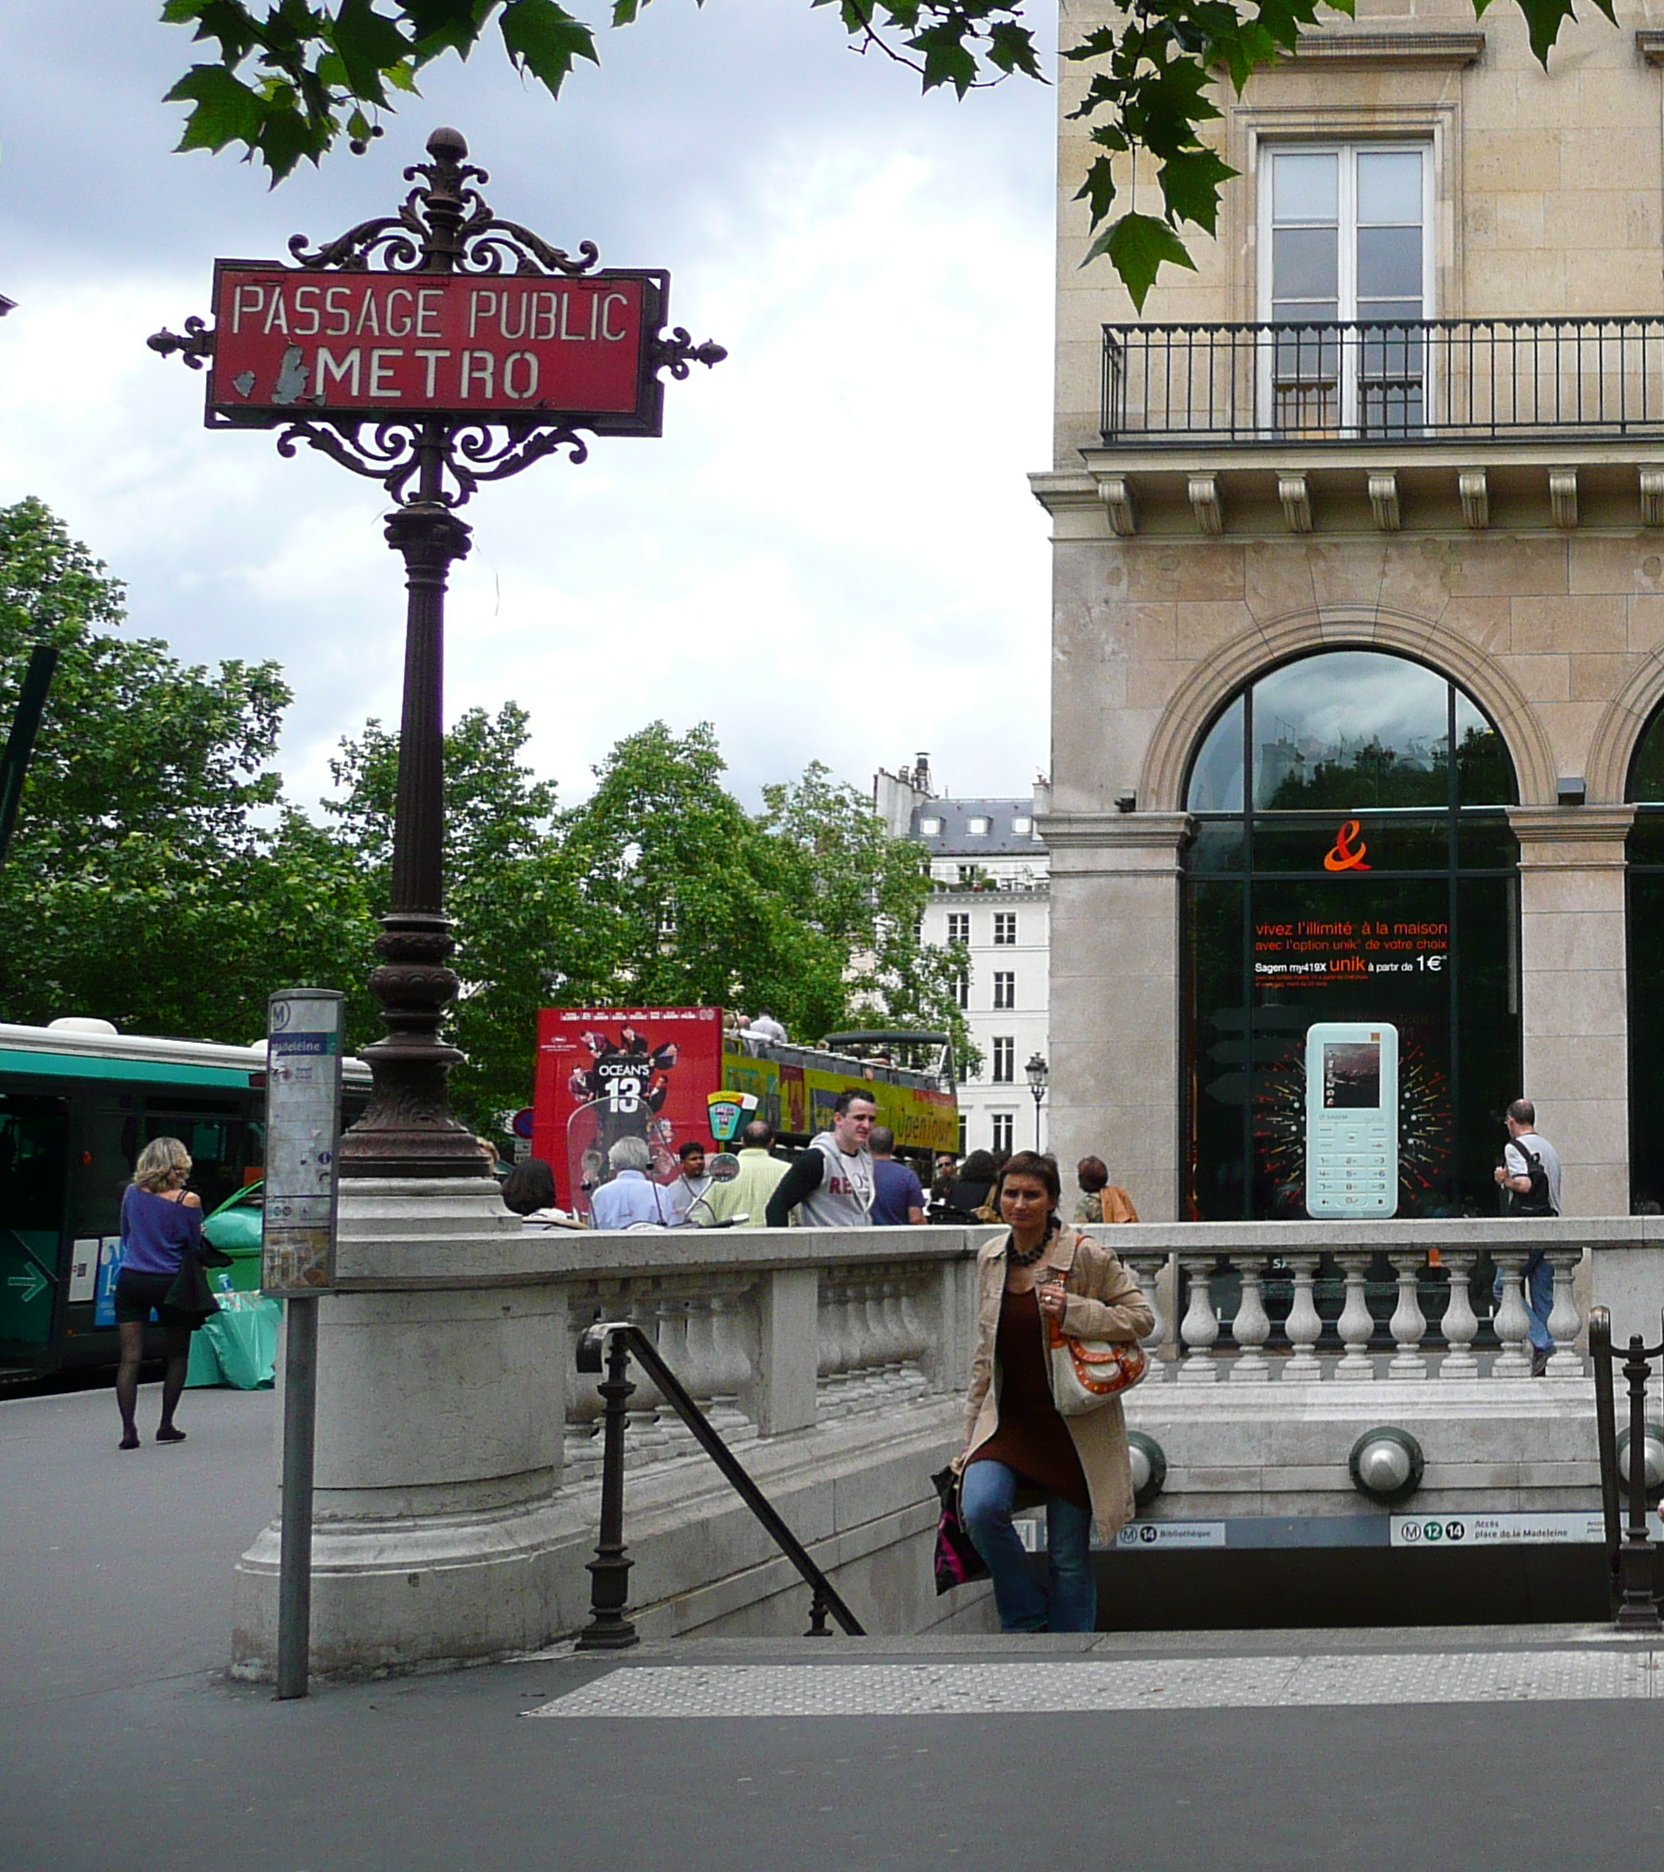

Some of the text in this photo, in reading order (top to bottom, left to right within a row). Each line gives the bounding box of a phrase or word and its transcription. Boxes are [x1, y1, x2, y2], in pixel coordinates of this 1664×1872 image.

[231, 284, 629, 342] PASSAGE PUBLIC
[314, 345, 540, 400] METRO
[1255, 922, 1293, 936] vivez
[1361, 920, 1372, 936] à
[1376, 921, 1389, 935] la
[1394, 922, 1448, 935] maison
[1255, 941, 1283, 951] avec
[1286, 939, 1330, 953] l'option
[1364, 939, 1380, 950] de
[1384, 941, 1413, 950] votre
[1416, 939, 1448, 950] choix
[1254, 962, 1288, 975] Sagem
[1329, 955, 1366, 972] unik
[1367, 962, 1375, 972] à
[1376, 961, 1399, 973] partir
[1400, 961, 1414, 972] de
[598, 1064, 650, 1077] OCEAN'S
[604, 1077, 642, 1113] 13
[1142, 1527, 1156, 1541] 14
[1425, 1523, 1442, 1539] 12
[1447, 1523, 1463, 1538] 14
[1474, 1529, 1498, 1540] place
[1522, 1527, 1569, 1539] Madeleine
